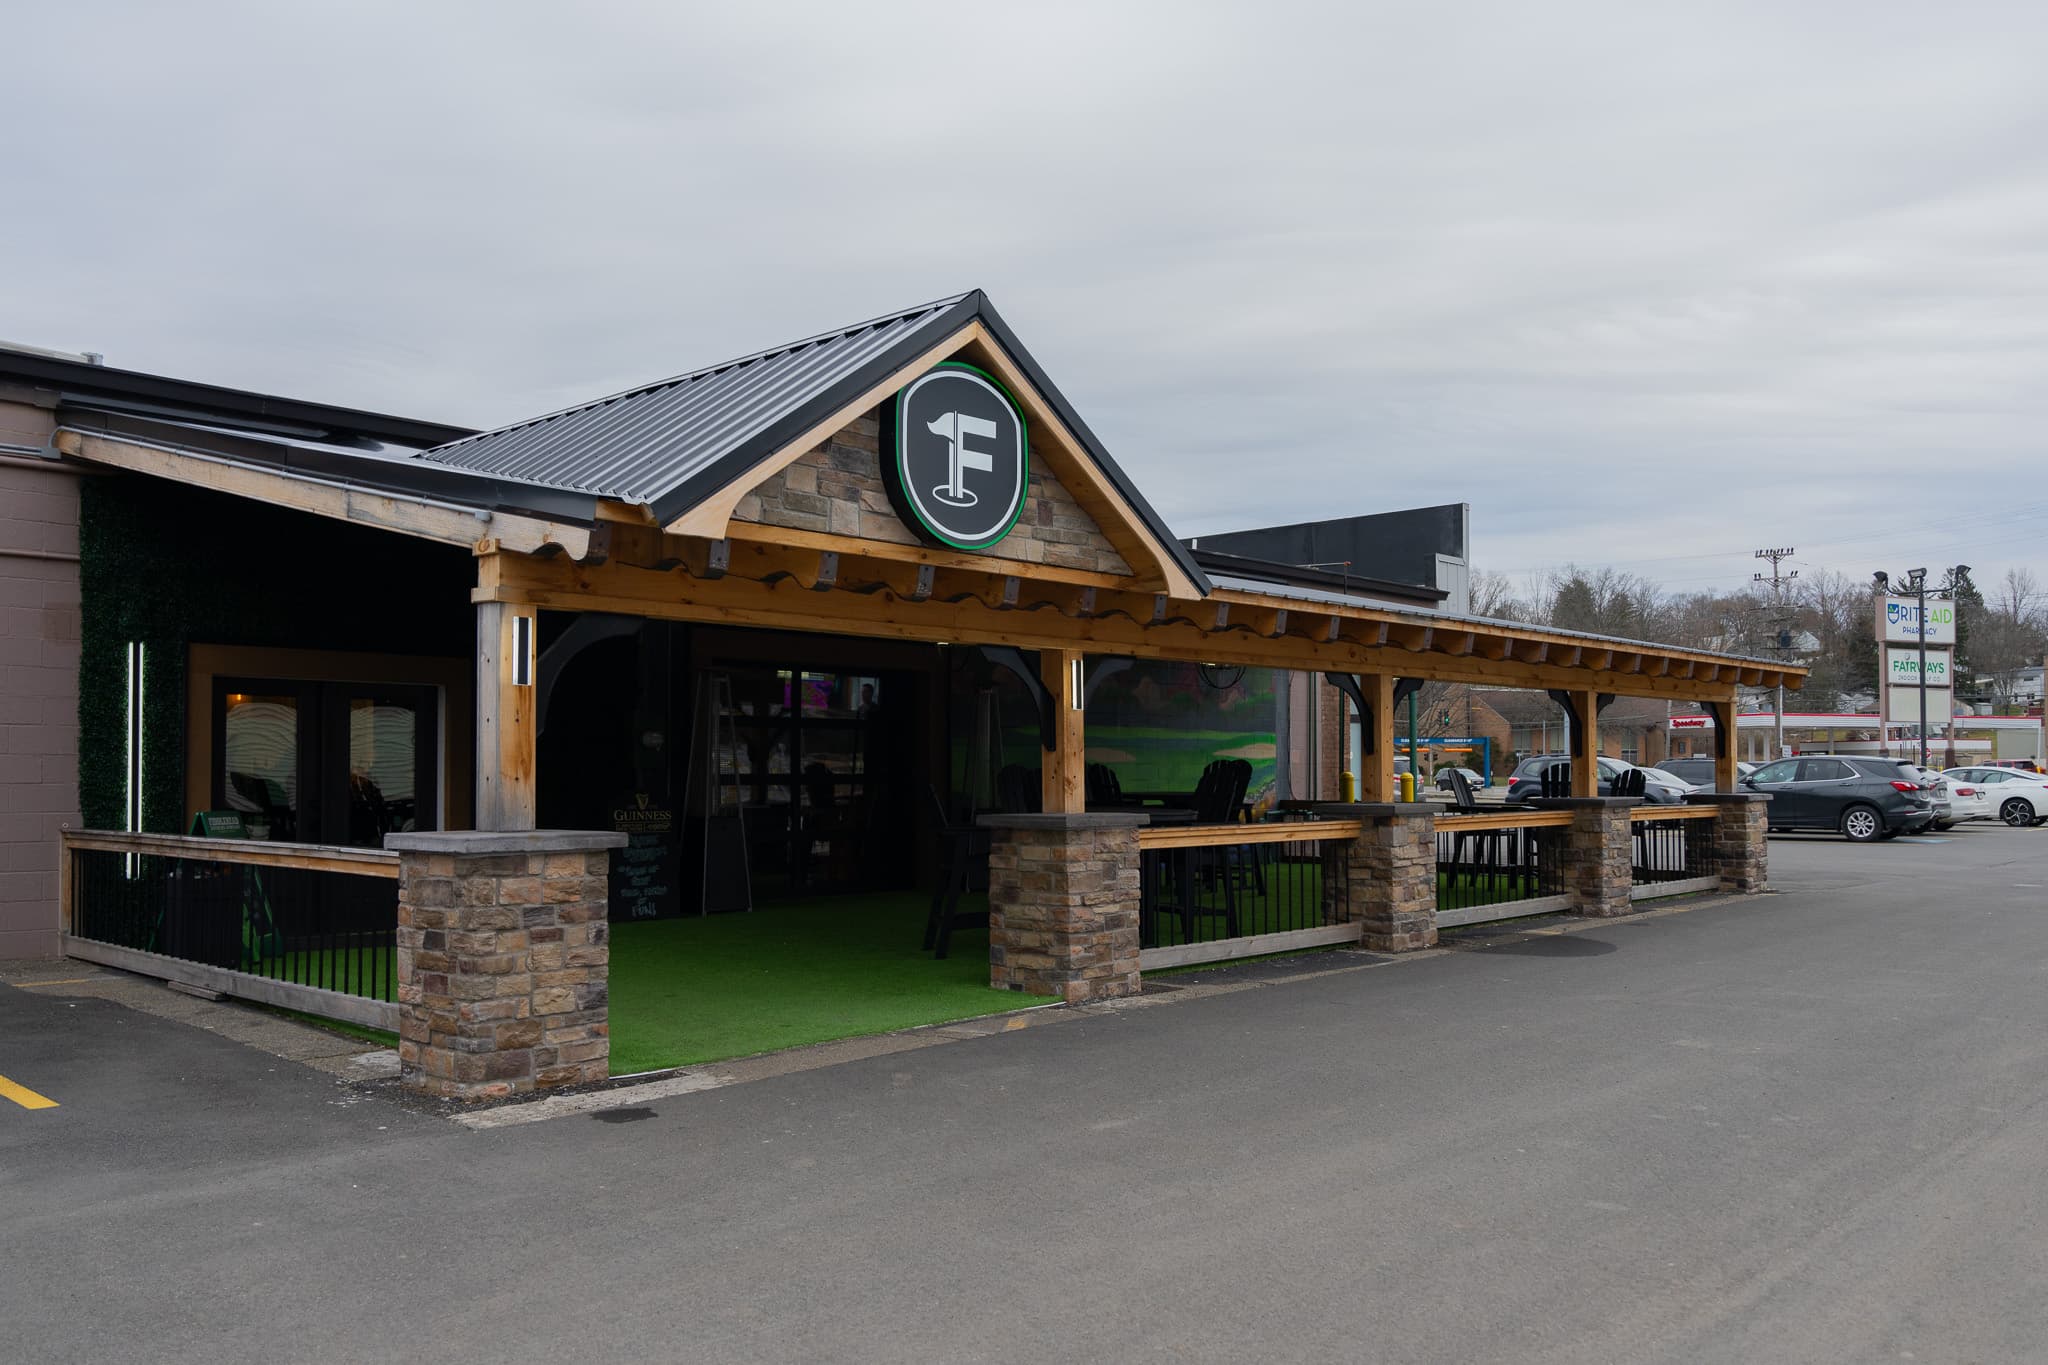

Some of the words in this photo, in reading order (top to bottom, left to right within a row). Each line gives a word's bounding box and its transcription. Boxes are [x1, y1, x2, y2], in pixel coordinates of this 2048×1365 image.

[1900, 606, 1929, 623] RITE
[1930, 608, 1953, 624] AID
[1902, 626, 1937, 635] PHARACY
[1672, 719, 1706, 728] Speedway
[613, 808, 673, 822] GUINNESS
